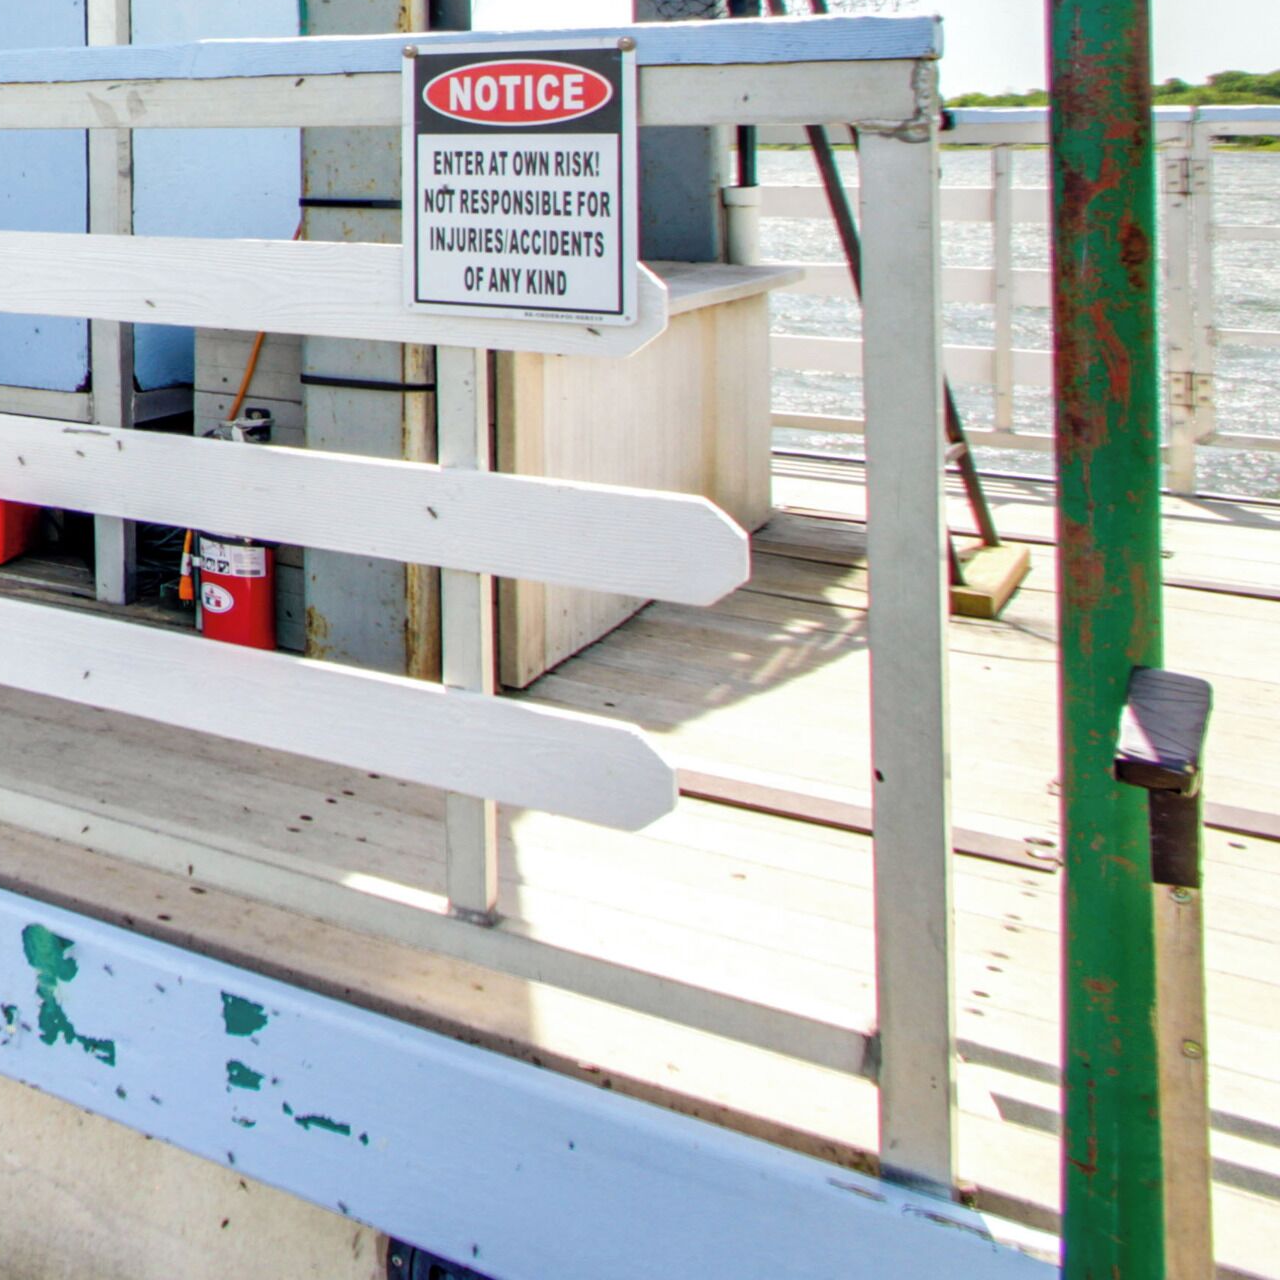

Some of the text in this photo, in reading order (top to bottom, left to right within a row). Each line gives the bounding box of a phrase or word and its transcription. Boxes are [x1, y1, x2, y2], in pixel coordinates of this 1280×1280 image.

[449, 74, 585, 111] NOTICE
[433, 151, 600, 177] ENTER AT OWN RISK!
[424, 188, 610, 218] NOT RESPONSIBLE FOR
[430, 226, 604, 257] INJURIES/ACCIDENTS
[464, 266, 567, 296] OF ANY KIND
